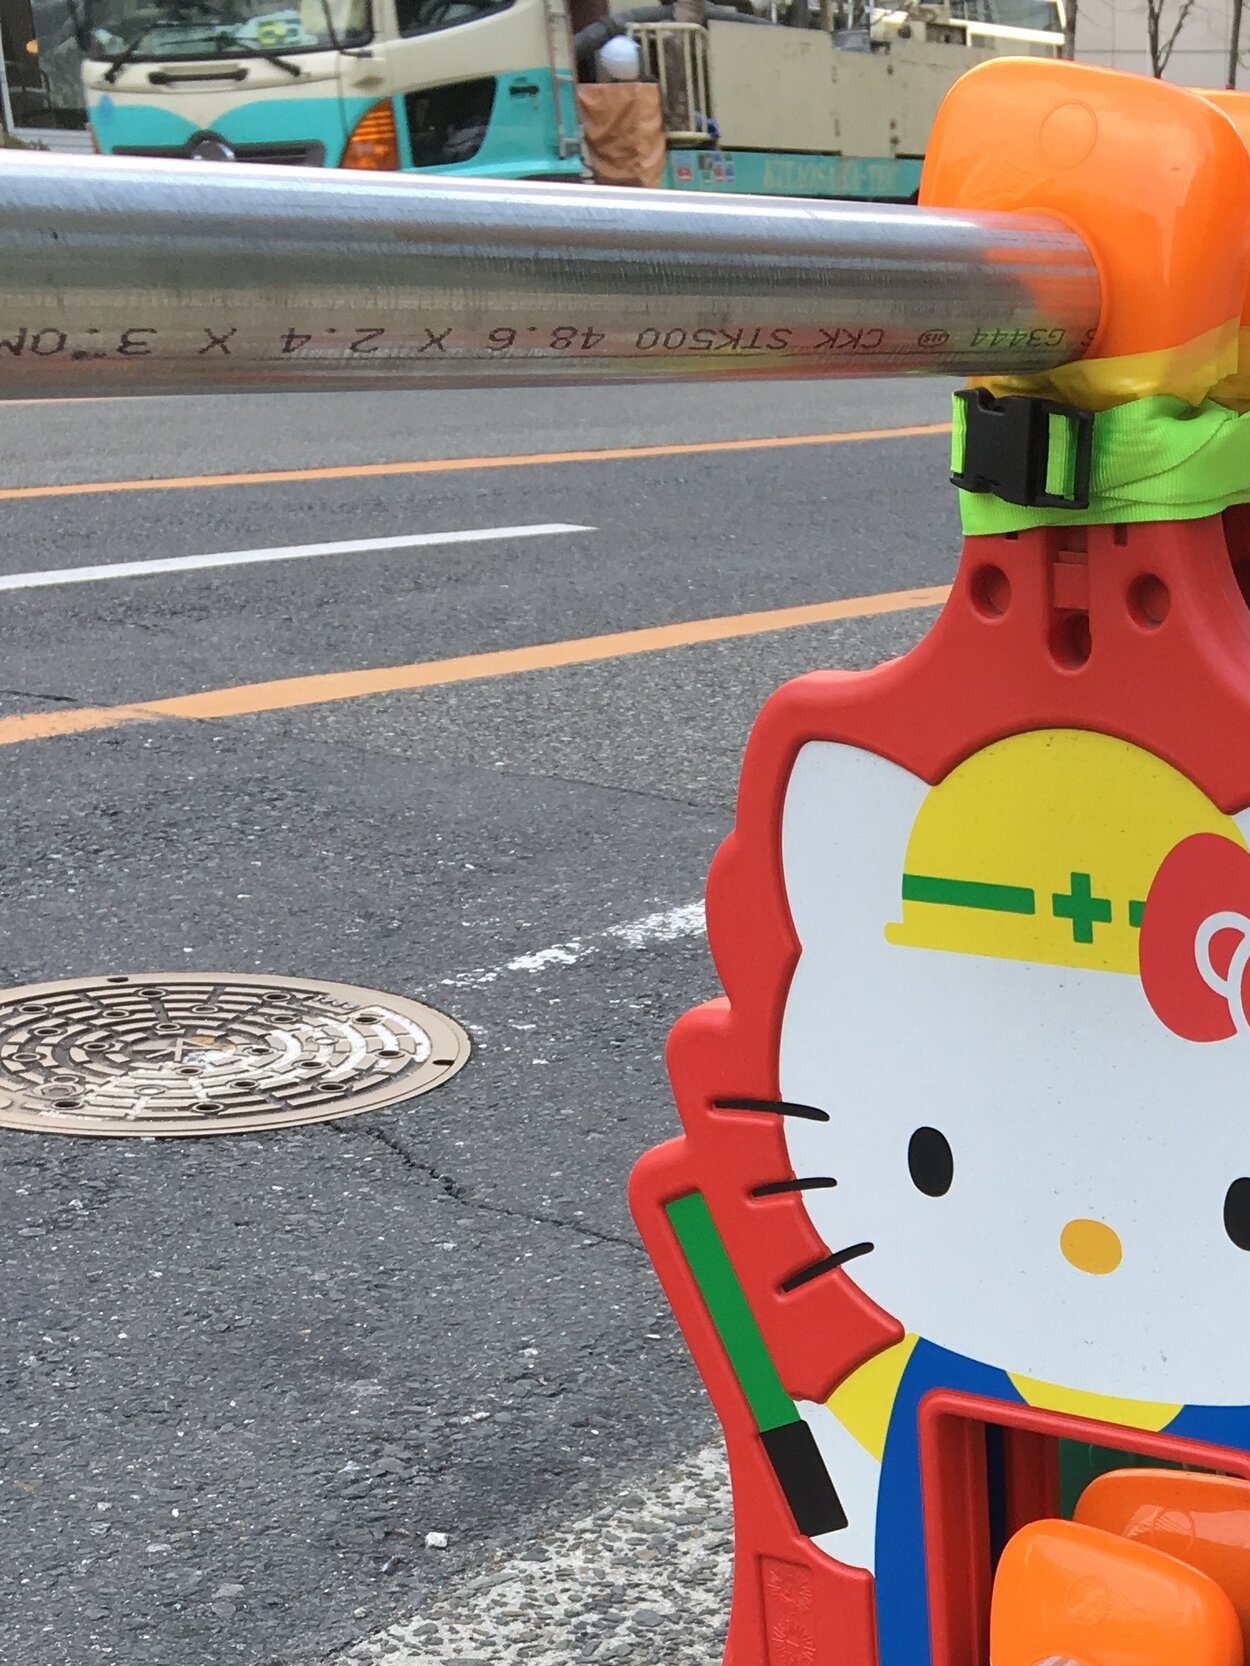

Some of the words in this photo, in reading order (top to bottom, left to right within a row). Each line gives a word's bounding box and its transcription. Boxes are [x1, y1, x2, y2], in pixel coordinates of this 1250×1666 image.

[199, 327, 238, 355] X
[280, 326, 387, 354] 2.4
[417, 327, 454, 353] X
[488, 325, 606, 351] 48.6
[635, 327, 793, 351] STK500
[815, 327, 886, 350] CKK
[970, 327, 1067, 349] G3444
